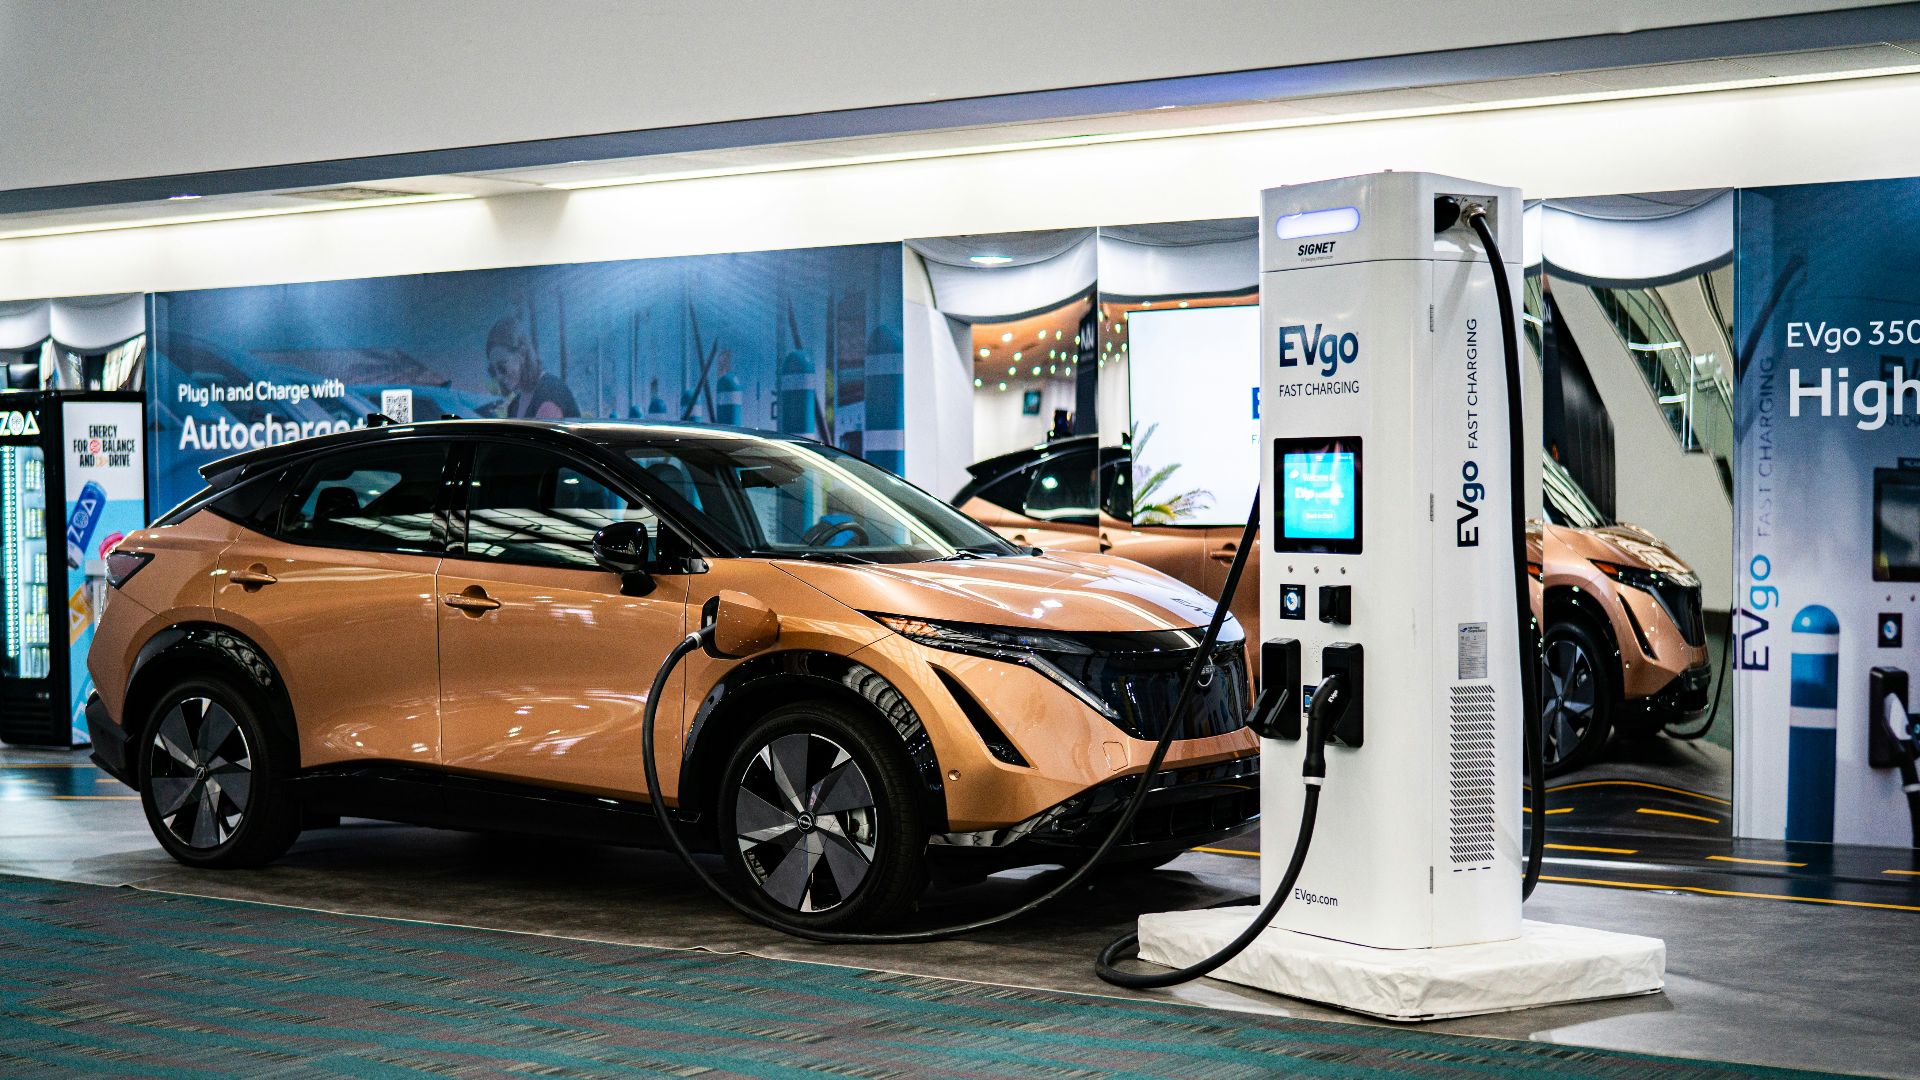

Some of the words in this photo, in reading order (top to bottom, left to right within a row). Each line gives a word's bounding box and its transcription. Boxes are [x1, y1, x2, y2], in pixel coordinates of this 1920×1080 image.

[1297, 241, 1337, 256] SIGNET
[1278, 323, 1359, 377] EVgo
[1787, 322, 1861, 353] EVgo
[1868, 320, 1920, 346] 350
[1466, 318, 1477, 406] CHARGING
[178, 383, 209, 407] Plug
[211, 383, 224, 401] In
[226, 383, 254, 401] and
[255, 380, 310, 404] Charge
[312, 378, 345, 399] with
[1279, 383, 1303, 397] FAST
[1304, 380, 1360, 396] CHARGING
[1789, 365, 1920, 431] High
[1467, 410, 1478, 449] FAST
[1758, 357, 1775, 477] CHARGING
[73, 439, 89, 453] FOR
[102, 439, 136, 453] BALANCE
[80, 454, 95, 467] AND
[108, 454, 131, 467] DRIVE
[1456, 460, 1486, 547] EVgo
[1757, 488, 1772, 537] FAST
[1741, 554, 1780, 671] EVgo
[1294, 888, 1338, 907] EVgo.com
